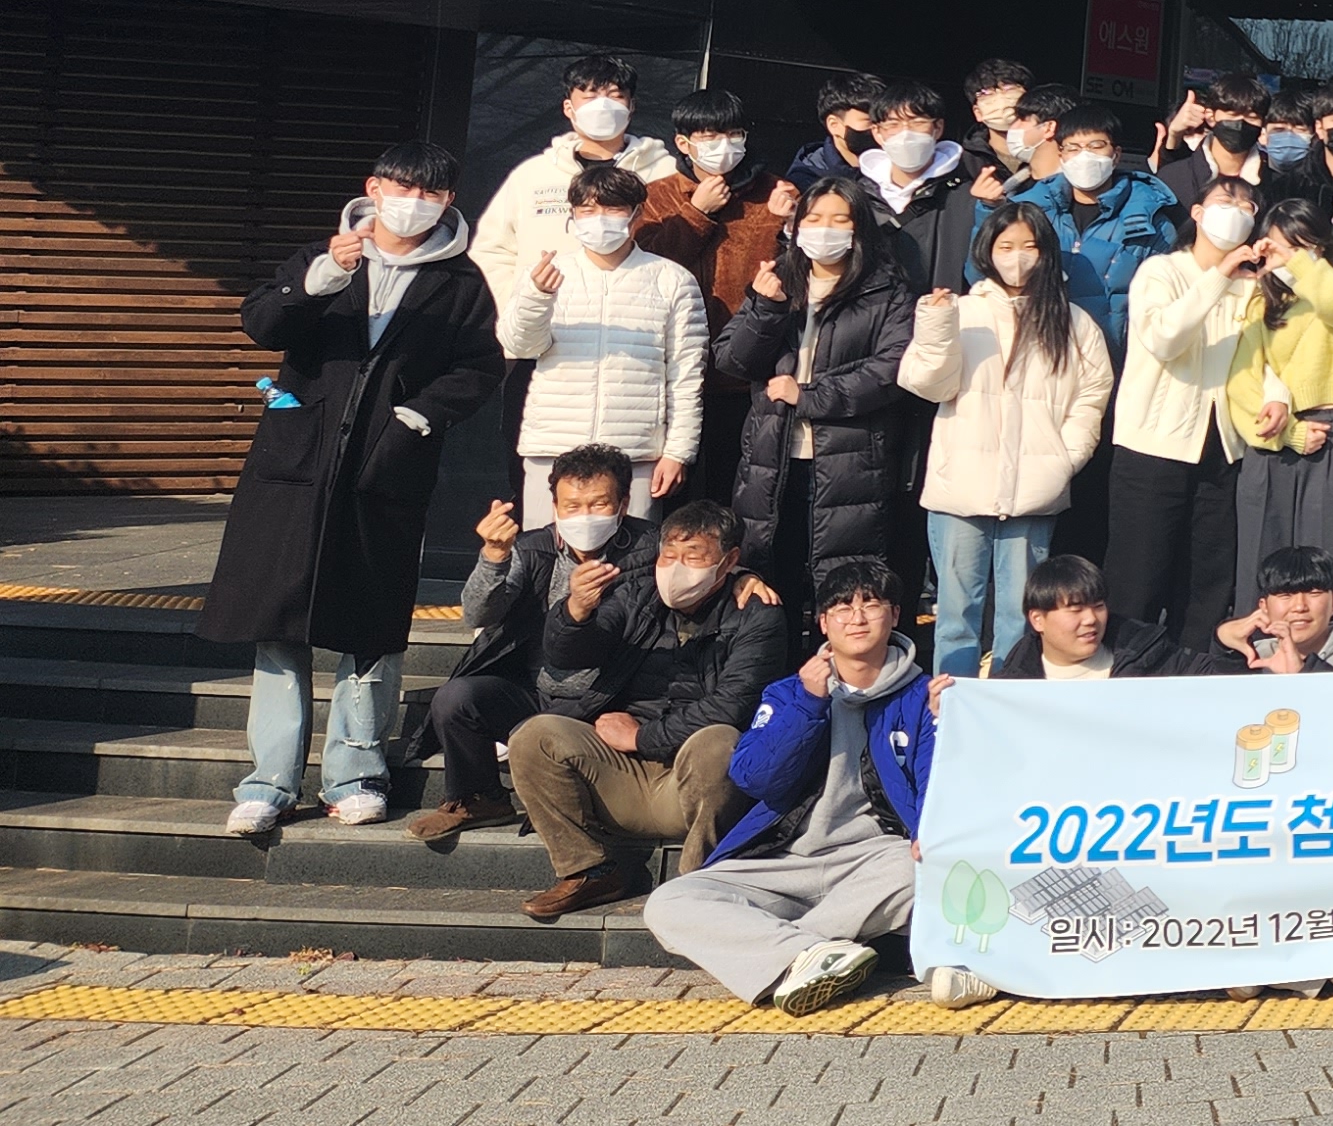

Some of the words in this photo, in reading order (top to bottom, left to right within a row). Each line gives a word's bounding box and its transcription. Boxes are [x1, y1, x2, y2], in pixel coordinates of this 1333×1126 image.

[1099, 21, 1149, 55] 에스원
[1009, 797, 1275, 865] 2022년도
[1050, 919, 1117, 954] 일시
[1141, 909, 1260, 950] 2022년
